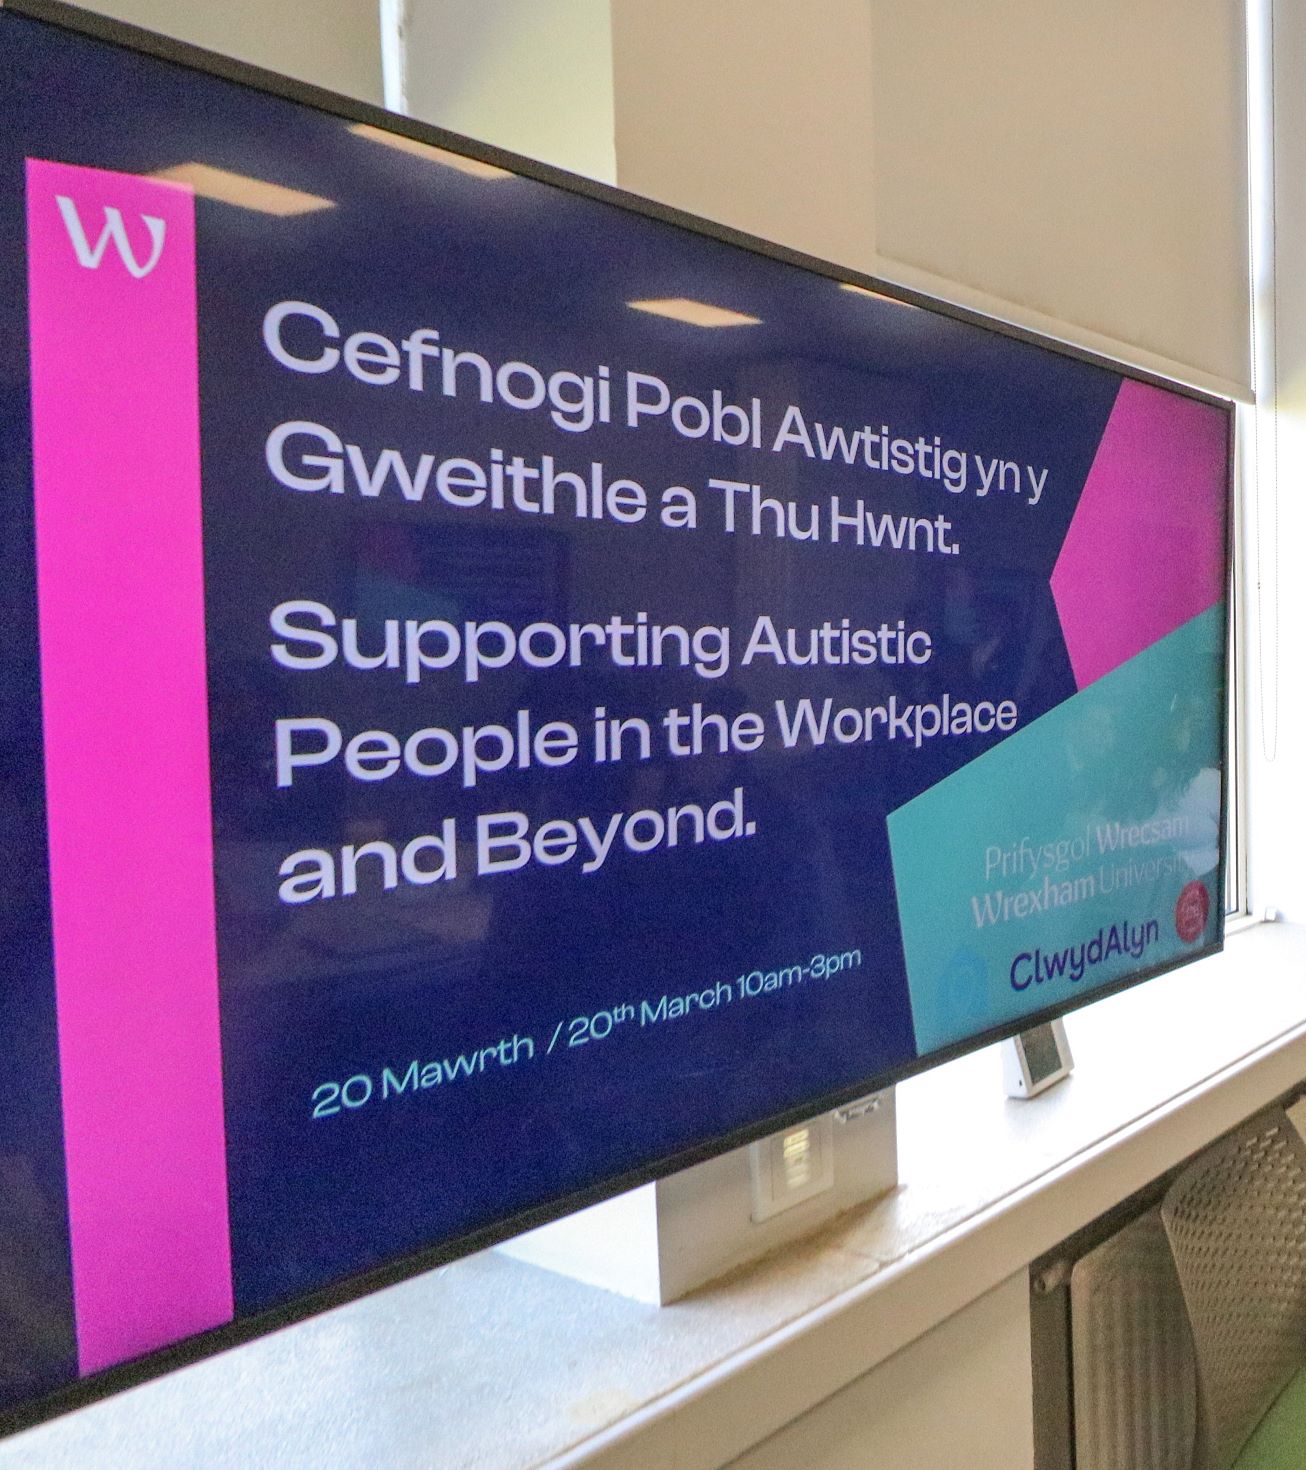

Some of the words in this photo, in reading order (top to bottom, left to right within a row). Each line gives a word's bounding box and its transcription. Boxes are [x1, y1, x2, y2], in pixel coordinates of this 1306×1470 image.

[263, 300, 611, 433] Cefnogi
[626, 371, 762, 449] Pobl
[771, 405, 967, 494] Awtistig
[974, 454, 1021, 497] yn
[1026, 465, 1049, 506] y
[265, 420, 647, 524] Gweithle
[660, 486, 697, 529] a
[708, 478, 819, 541] Thu
[830, 495, 960, 555] Hwnt.
[269, 599, 730, 684] Supporting
[741, 615, 932, 666] Autistic
[275, 709, 578, 788] People
[594, 706, 651, 762] in
[662, 702, 765, 756] the
[774, 693, 1018, 749] Workplace
[278, 818, 457, 904] and
[476, 786, 756, 876] Beyond.
[985, 826, 1091, 879] Prifysgol
[971, 874, 1096, 928] Wrexham
[1009, 919, 1159, 992] ClwydAlyn
[311, 1074, 373, 1119] 20
[381, 1034, 535, 1099] Mawrth
[640, 981, 733, 1027] March
[736, 947, 862, 1000] 10am-3pm
